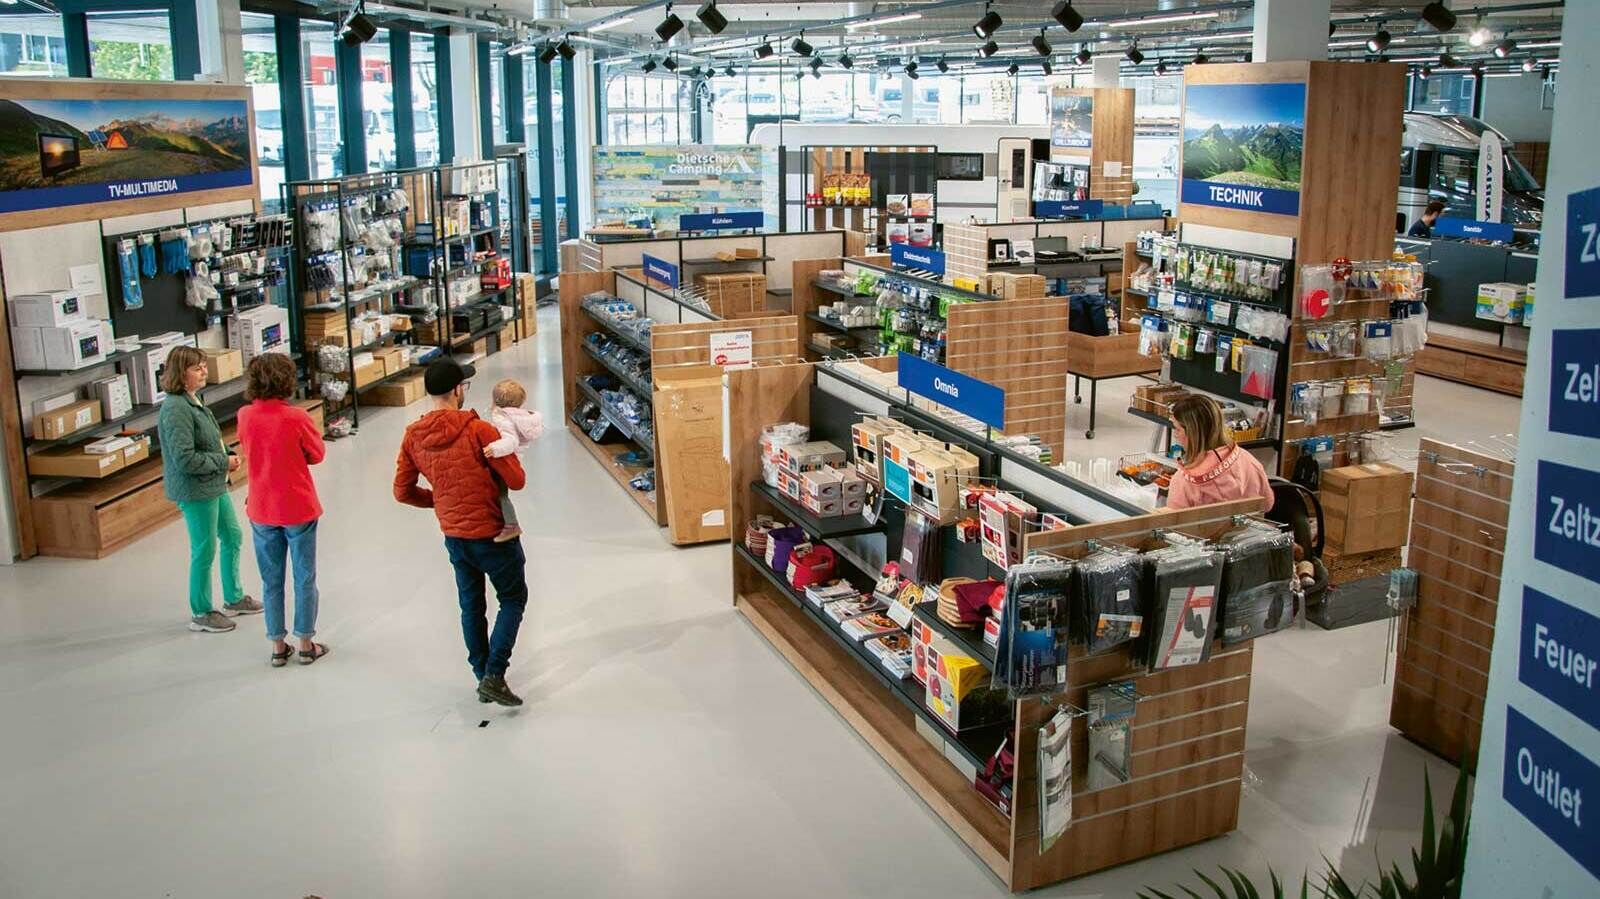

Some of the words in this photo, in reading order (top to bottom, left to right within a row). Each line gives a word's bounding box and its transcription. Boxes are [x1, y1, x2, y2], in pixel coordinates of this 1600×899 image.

[677, 152, 730, 164] Dietsche
[669, 164, 722, 176] Camping
[108, 179, 178, 198] TV-MULTIMEDIA
[1209, 185, 1263, 207] TECHNIK
[934, 377, 959, 398] Omnia
[1534, 622, 1597, 689] Feuer
[1517, 747, 1582, 828] Outlet
